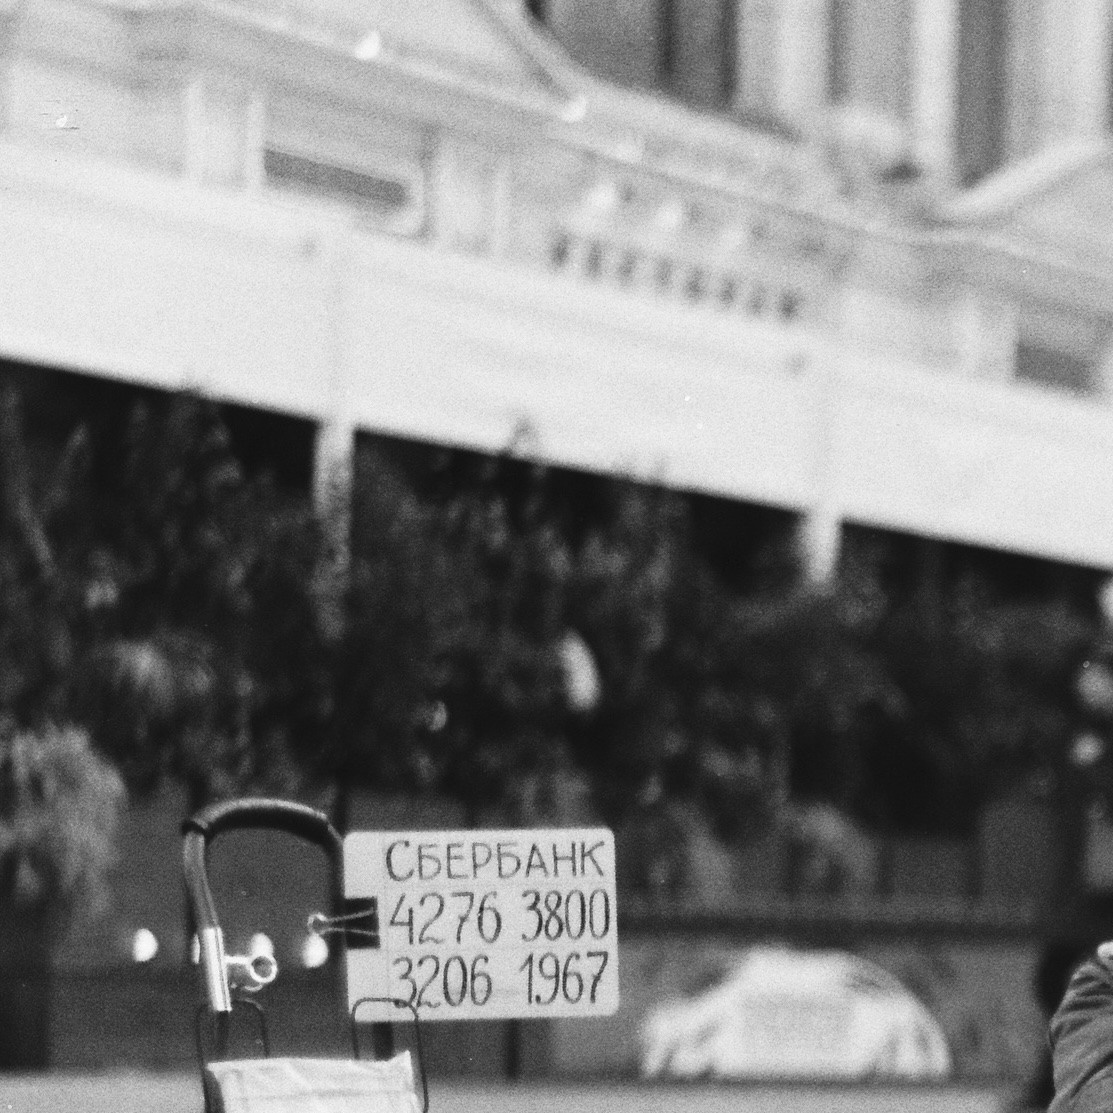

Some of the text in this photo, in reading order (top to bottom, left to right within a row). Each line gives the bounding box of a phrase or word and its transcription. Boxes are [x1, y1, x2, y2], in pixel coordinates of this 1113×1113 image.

[386, 840, 605, 882] СБЕРБАНК
[389, 888, 611, 946] 4276 3800
[392, 951, 609, 1008] 3206 1967
